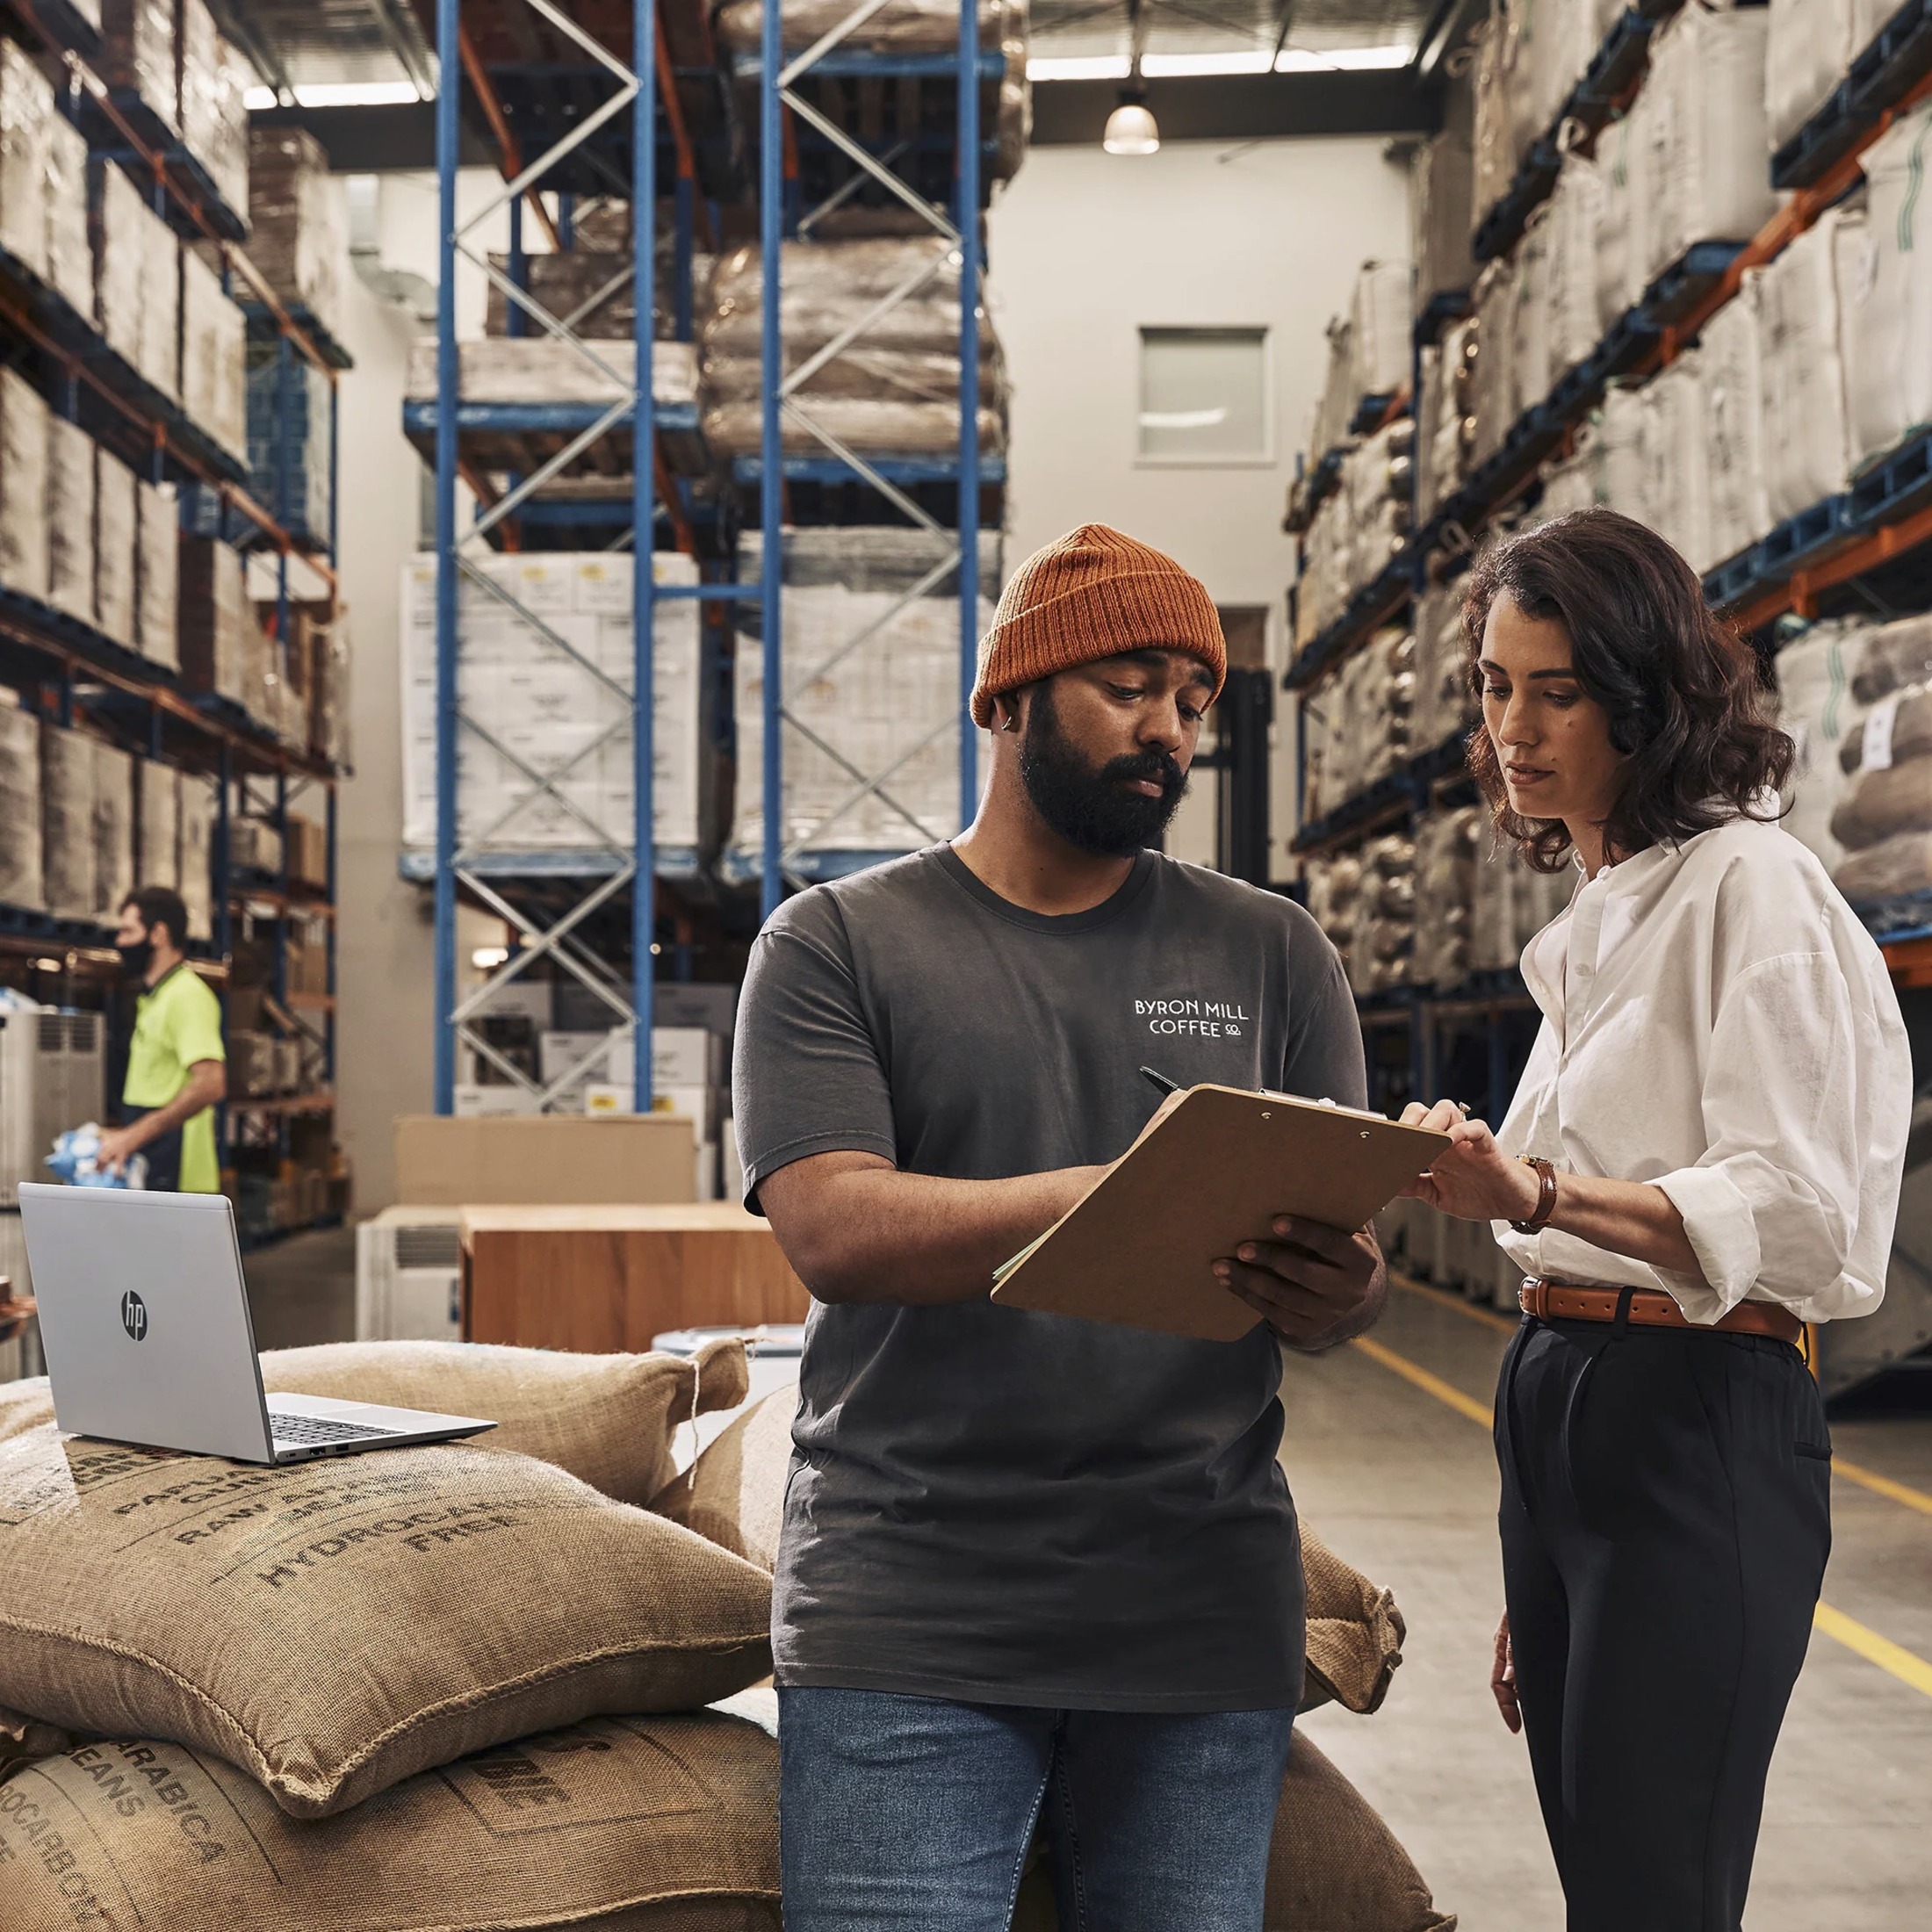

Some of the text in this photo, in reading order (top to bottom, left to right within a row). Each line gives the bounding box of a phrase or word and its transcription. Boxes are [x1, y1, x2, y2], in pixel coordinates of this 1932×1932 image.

[1135, 999, 1249, 1020] BYRON MILL
[1150, 1020, 1221, 1037] COFFEE
[124, 1289, 145, 1341] hp
[174, 1503, 269, 1546] RAW
[400, 1515, 529, 1554] FREE
[67, 1745, 147, 1817] EANS
[108, 1740, 225, 1864] ARABICA
